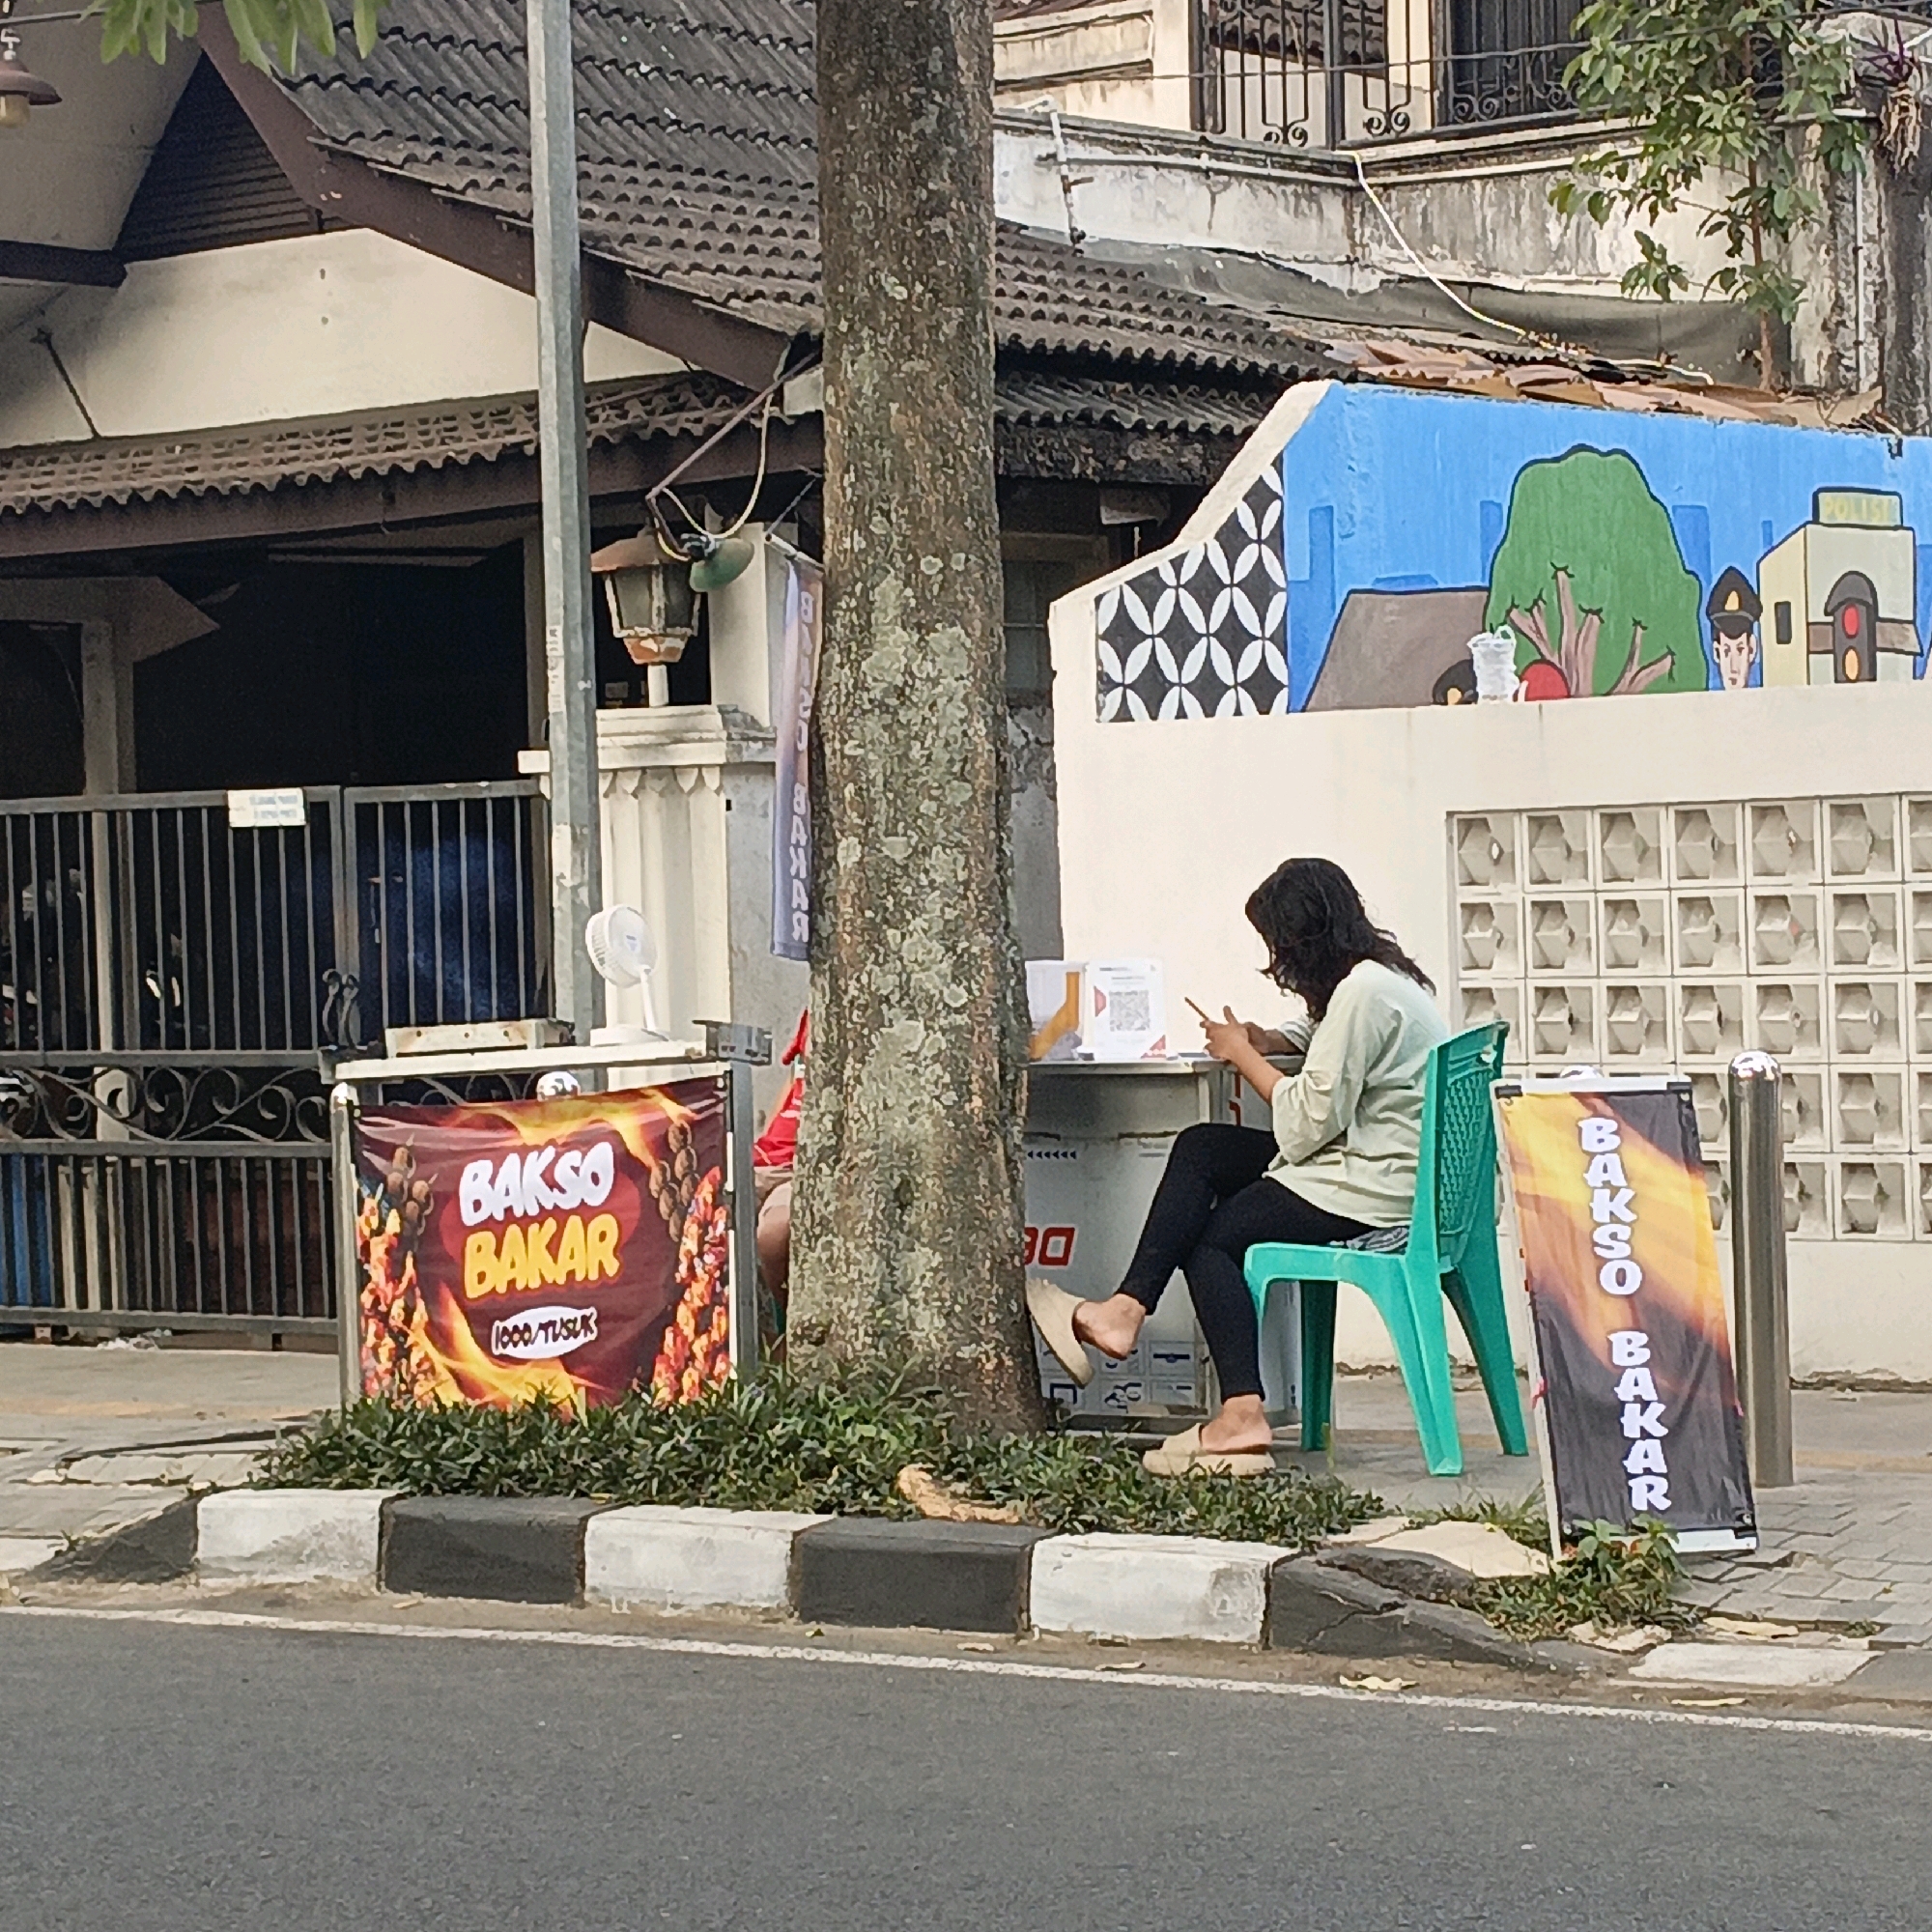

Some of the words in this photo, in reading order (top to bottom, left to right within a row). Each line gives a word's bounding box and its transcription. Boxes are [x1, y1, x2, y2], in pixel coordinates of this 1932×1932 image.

[459, 1141, 615, 1227] BAKSO
[1577, 1117, 1642, 1295] BAKSO
[464, 1213, 621, 1300] BAKAR
[495, 1311, 595, 1350] 1000/TUSUK
[1606, 1331, 1672, 1512] BAKAR
